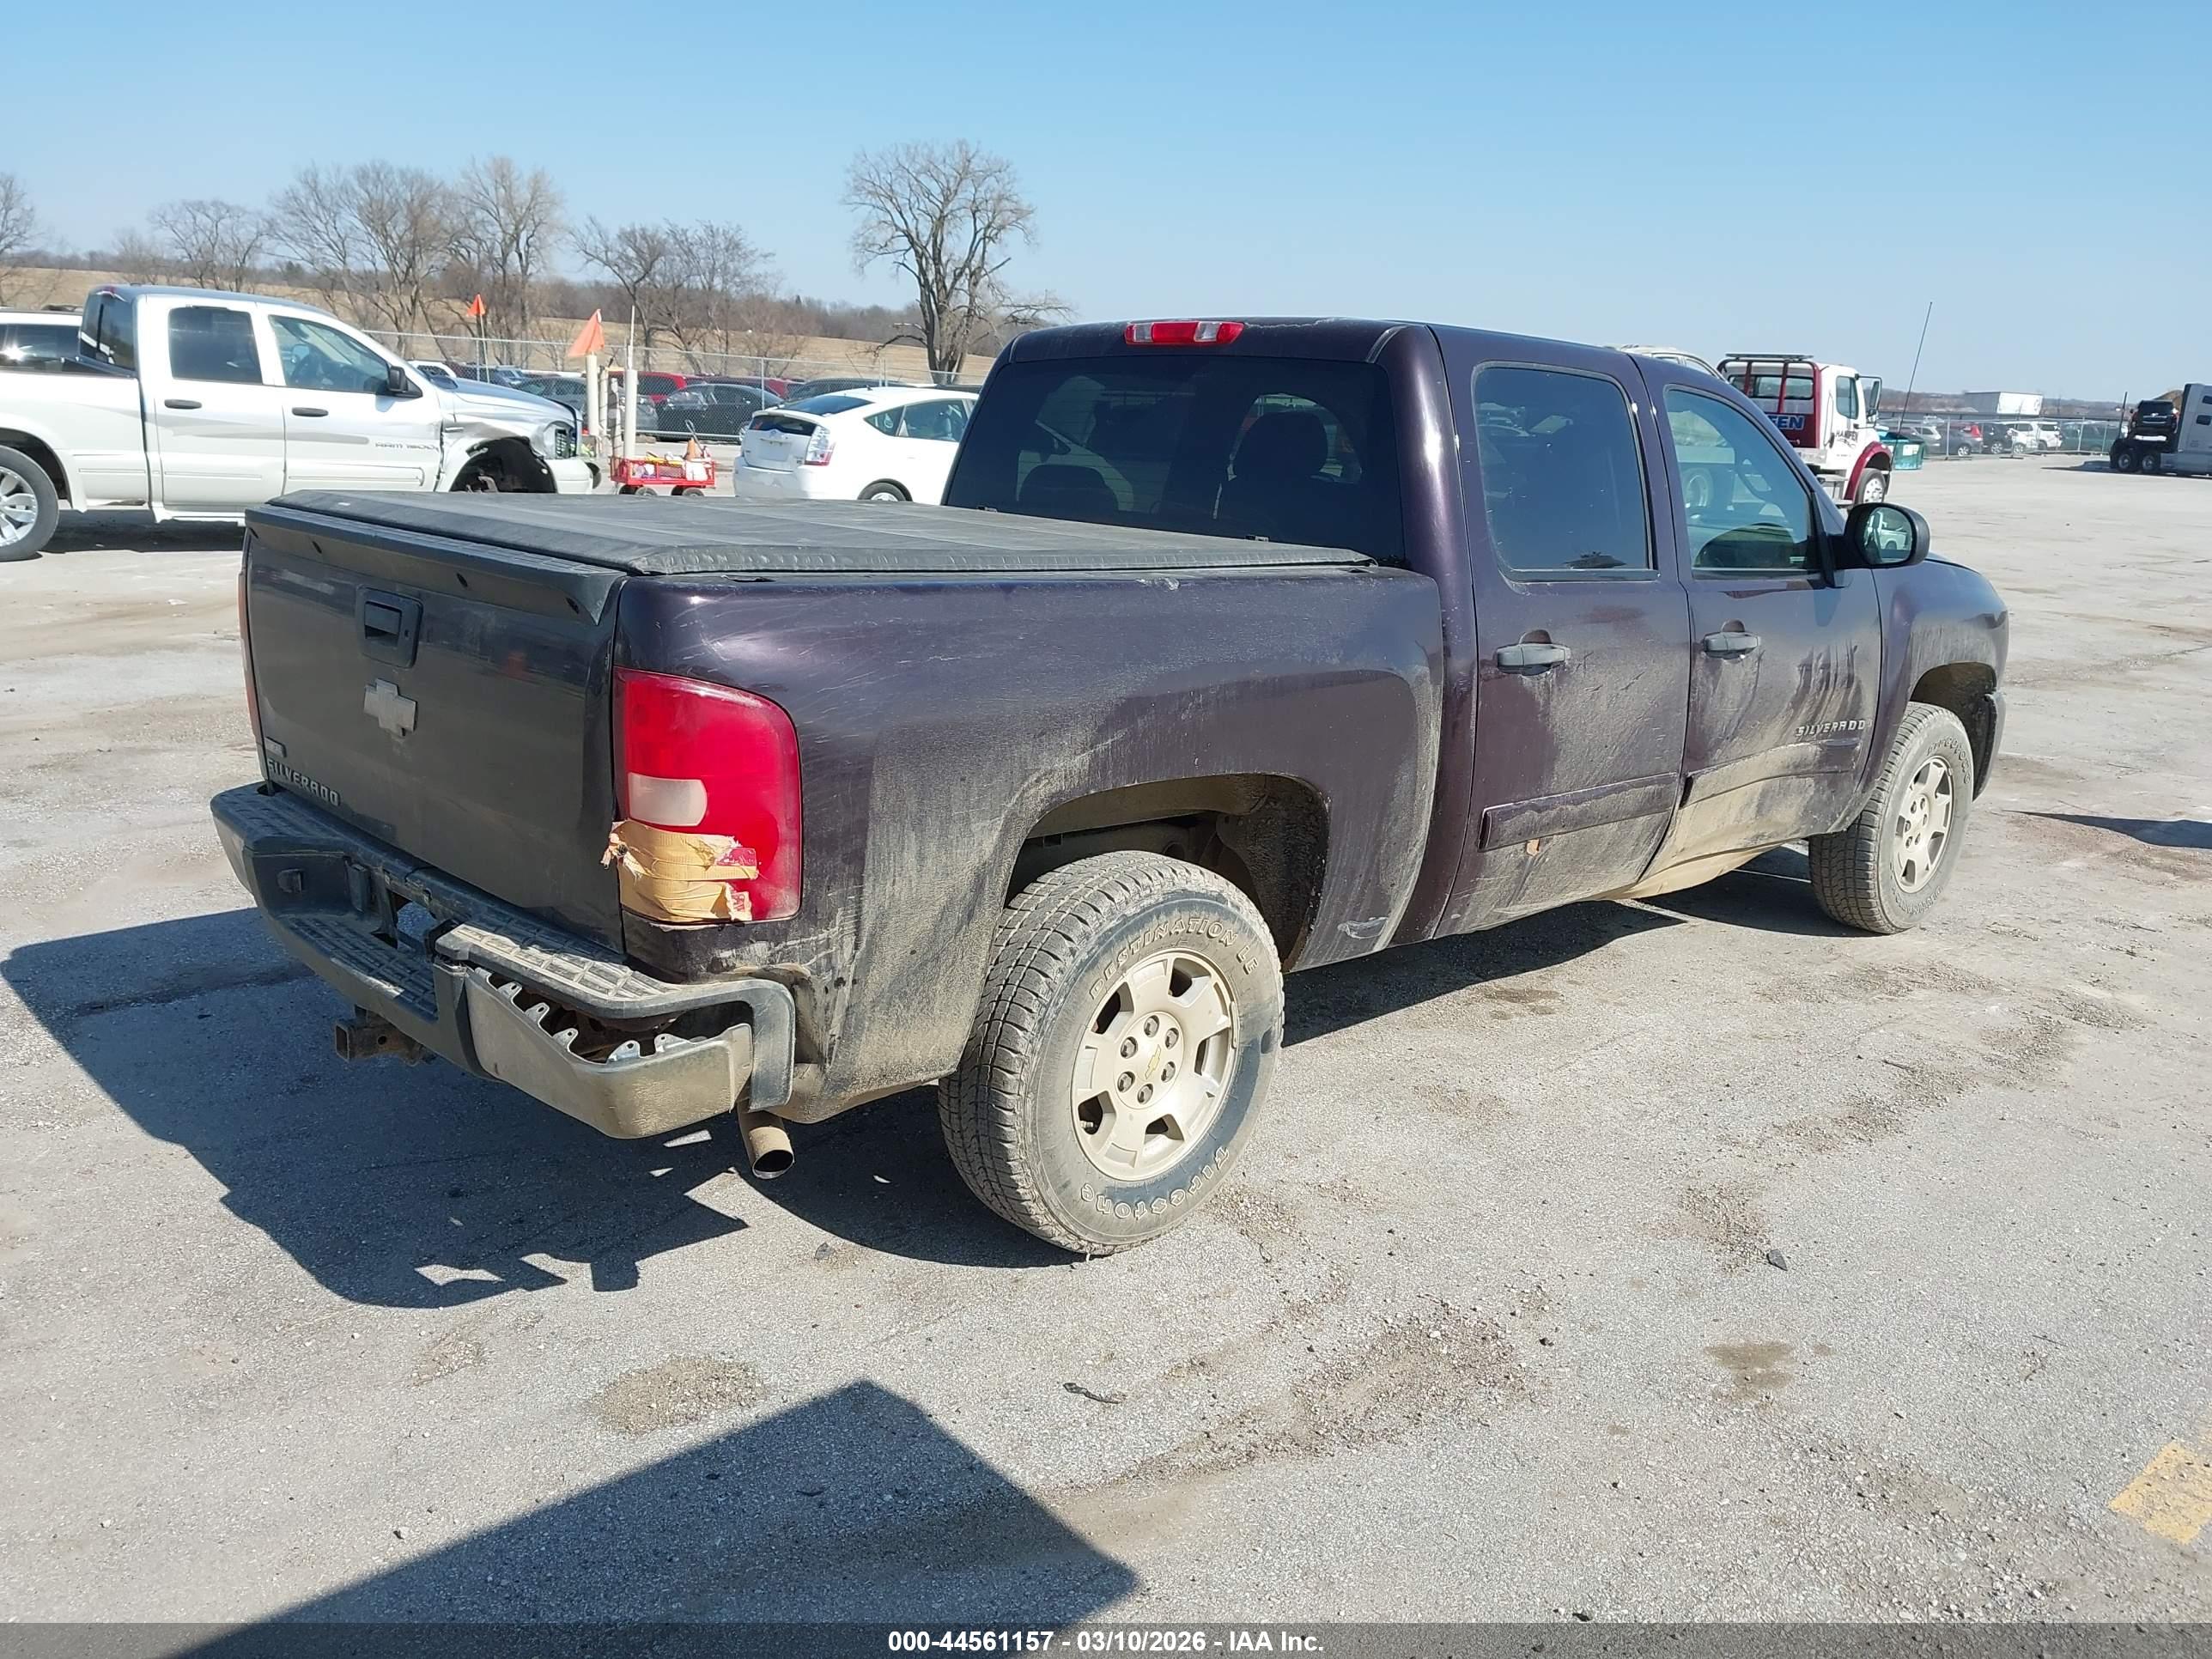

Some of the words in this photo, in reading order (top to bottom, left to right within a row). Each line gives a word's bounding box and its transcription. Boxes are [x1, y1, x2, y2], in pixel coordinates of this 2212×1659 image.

[1796, 720, 1867, 738] SILVERADO
[267, 759, 341, 807] SILVERADO
[1090, 918, 1237, 1001] DESTINATION
[1236, 943, 1260, 976] LE
